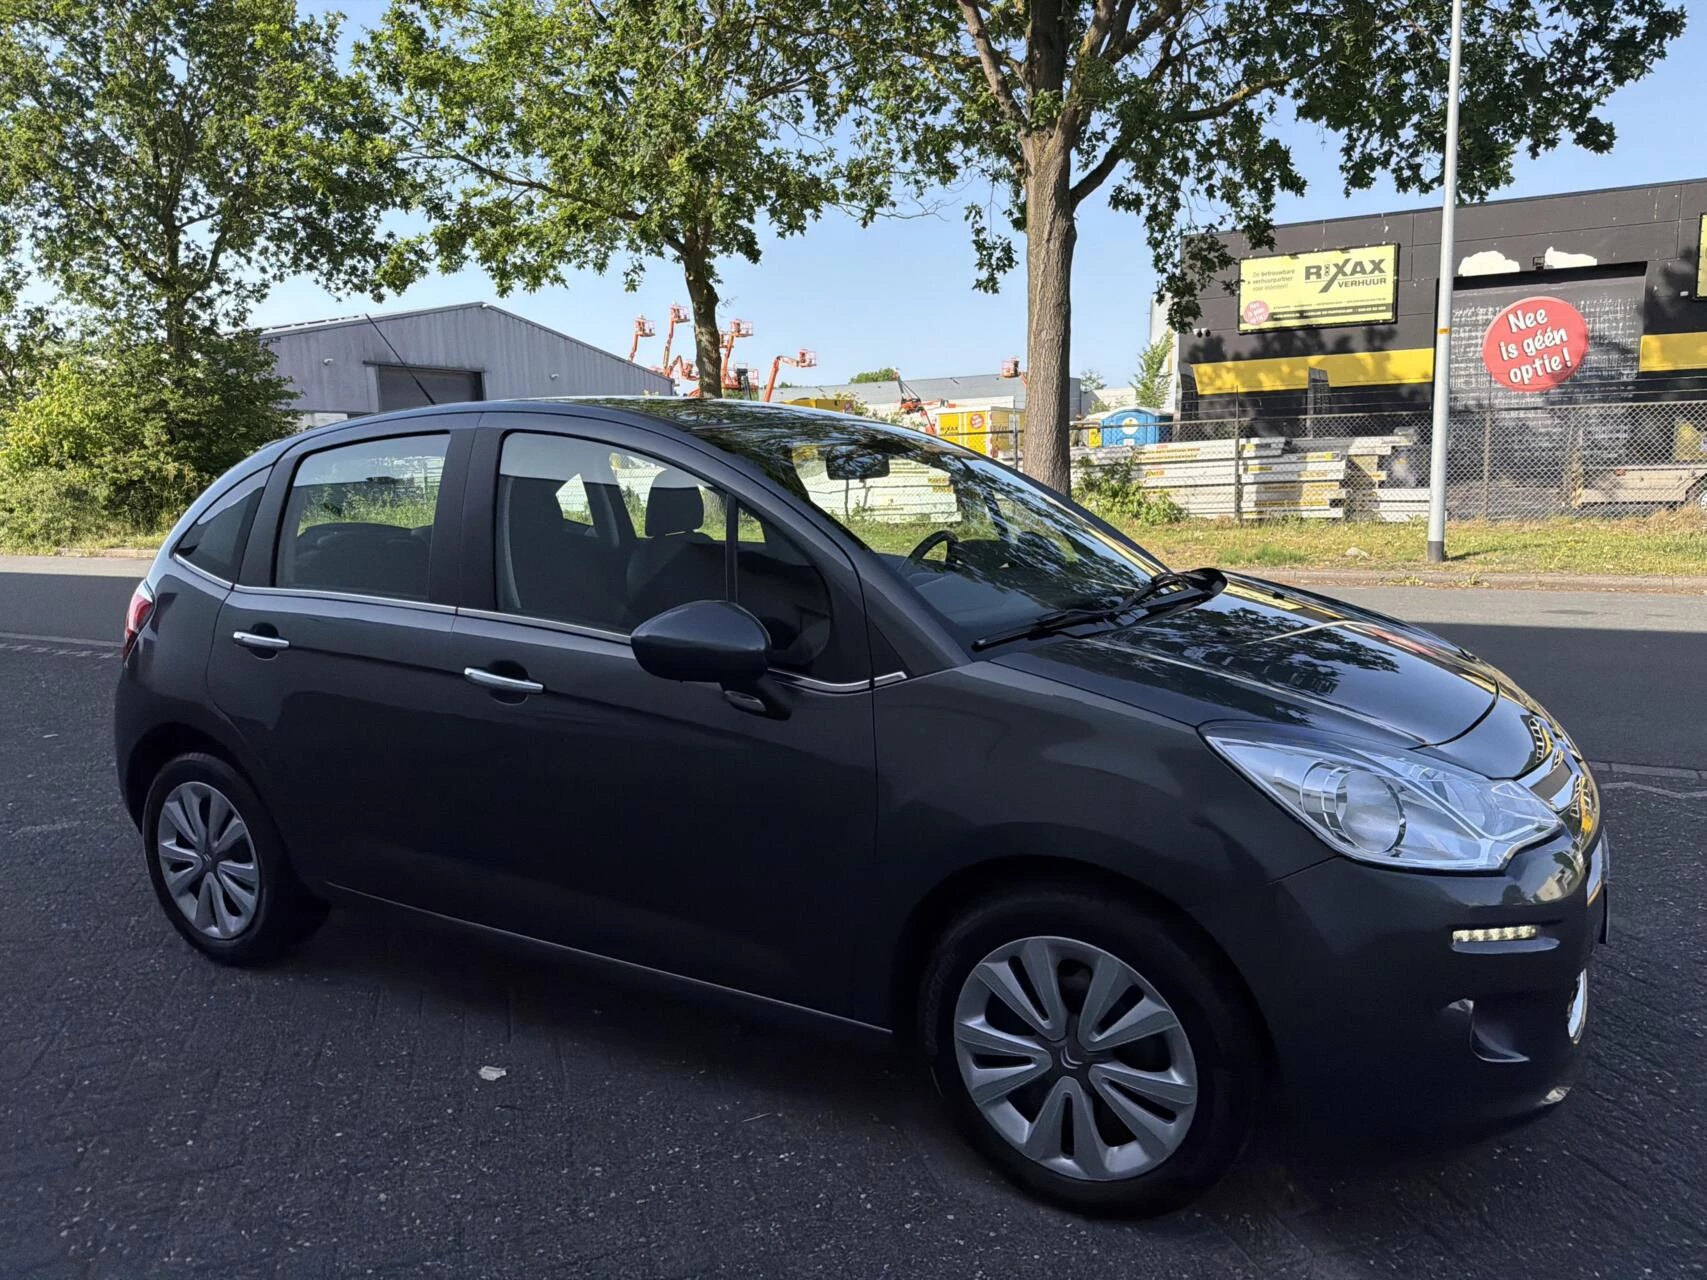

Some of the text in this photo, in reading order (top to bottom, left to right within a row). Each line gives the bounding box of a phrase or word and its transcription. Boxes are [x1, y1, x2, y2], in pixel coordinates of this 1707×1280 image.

[1338, 277, 1387, 289] VERHUUR
[1508, 308, 1548, 333] Nee
[1500, 327, 1568, 361] is géén
